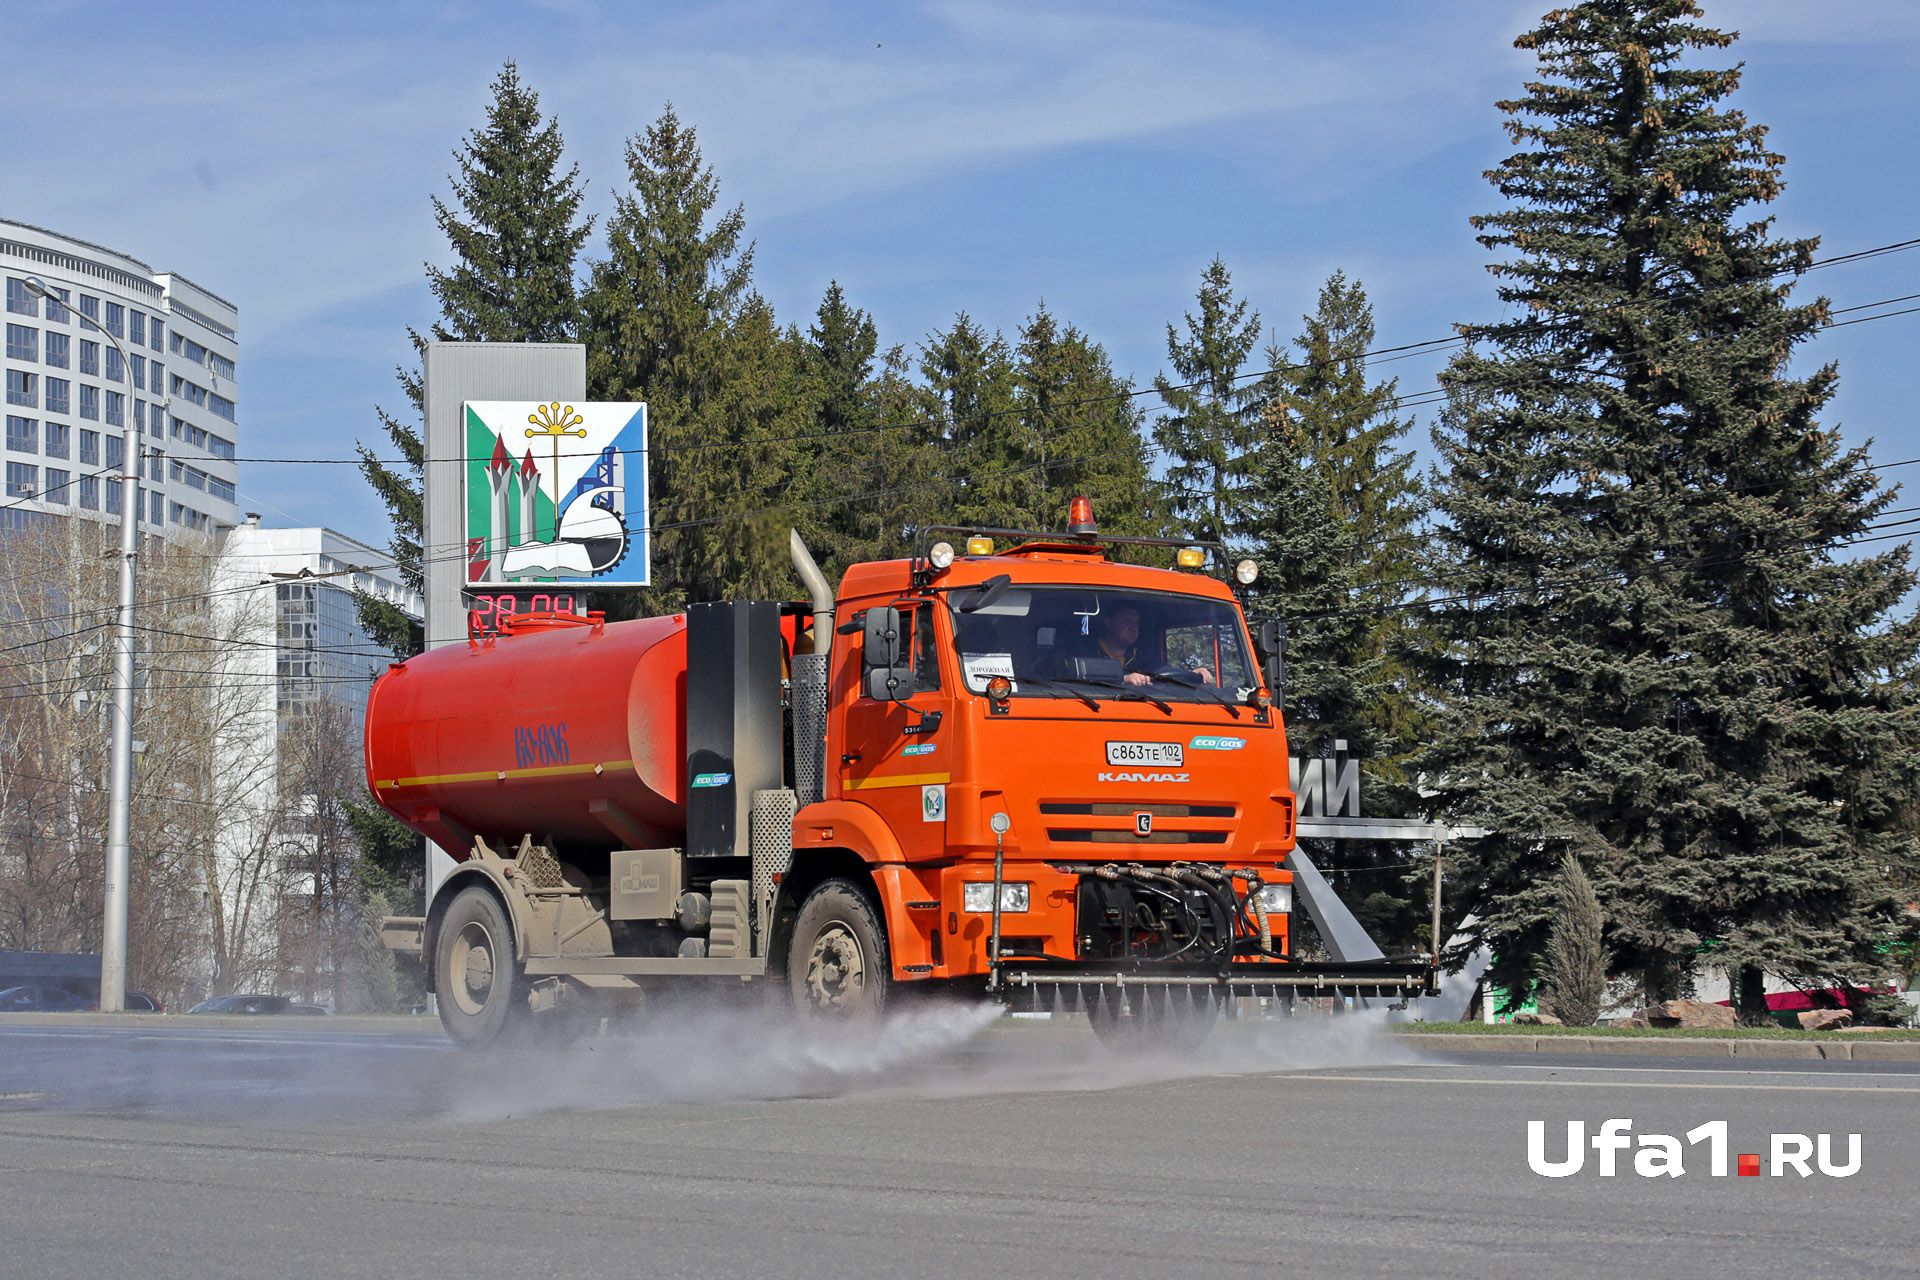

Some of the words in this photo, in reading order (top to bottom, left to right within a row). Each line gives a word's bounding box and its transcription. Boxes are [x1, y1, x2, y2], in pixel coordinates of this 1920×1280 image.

[969, 666, 1010, 674] ДОРОЖНАЯ
[1161, 745, 1179, 757] 102
[1098, 772, 1190, 782] KAMAZ
